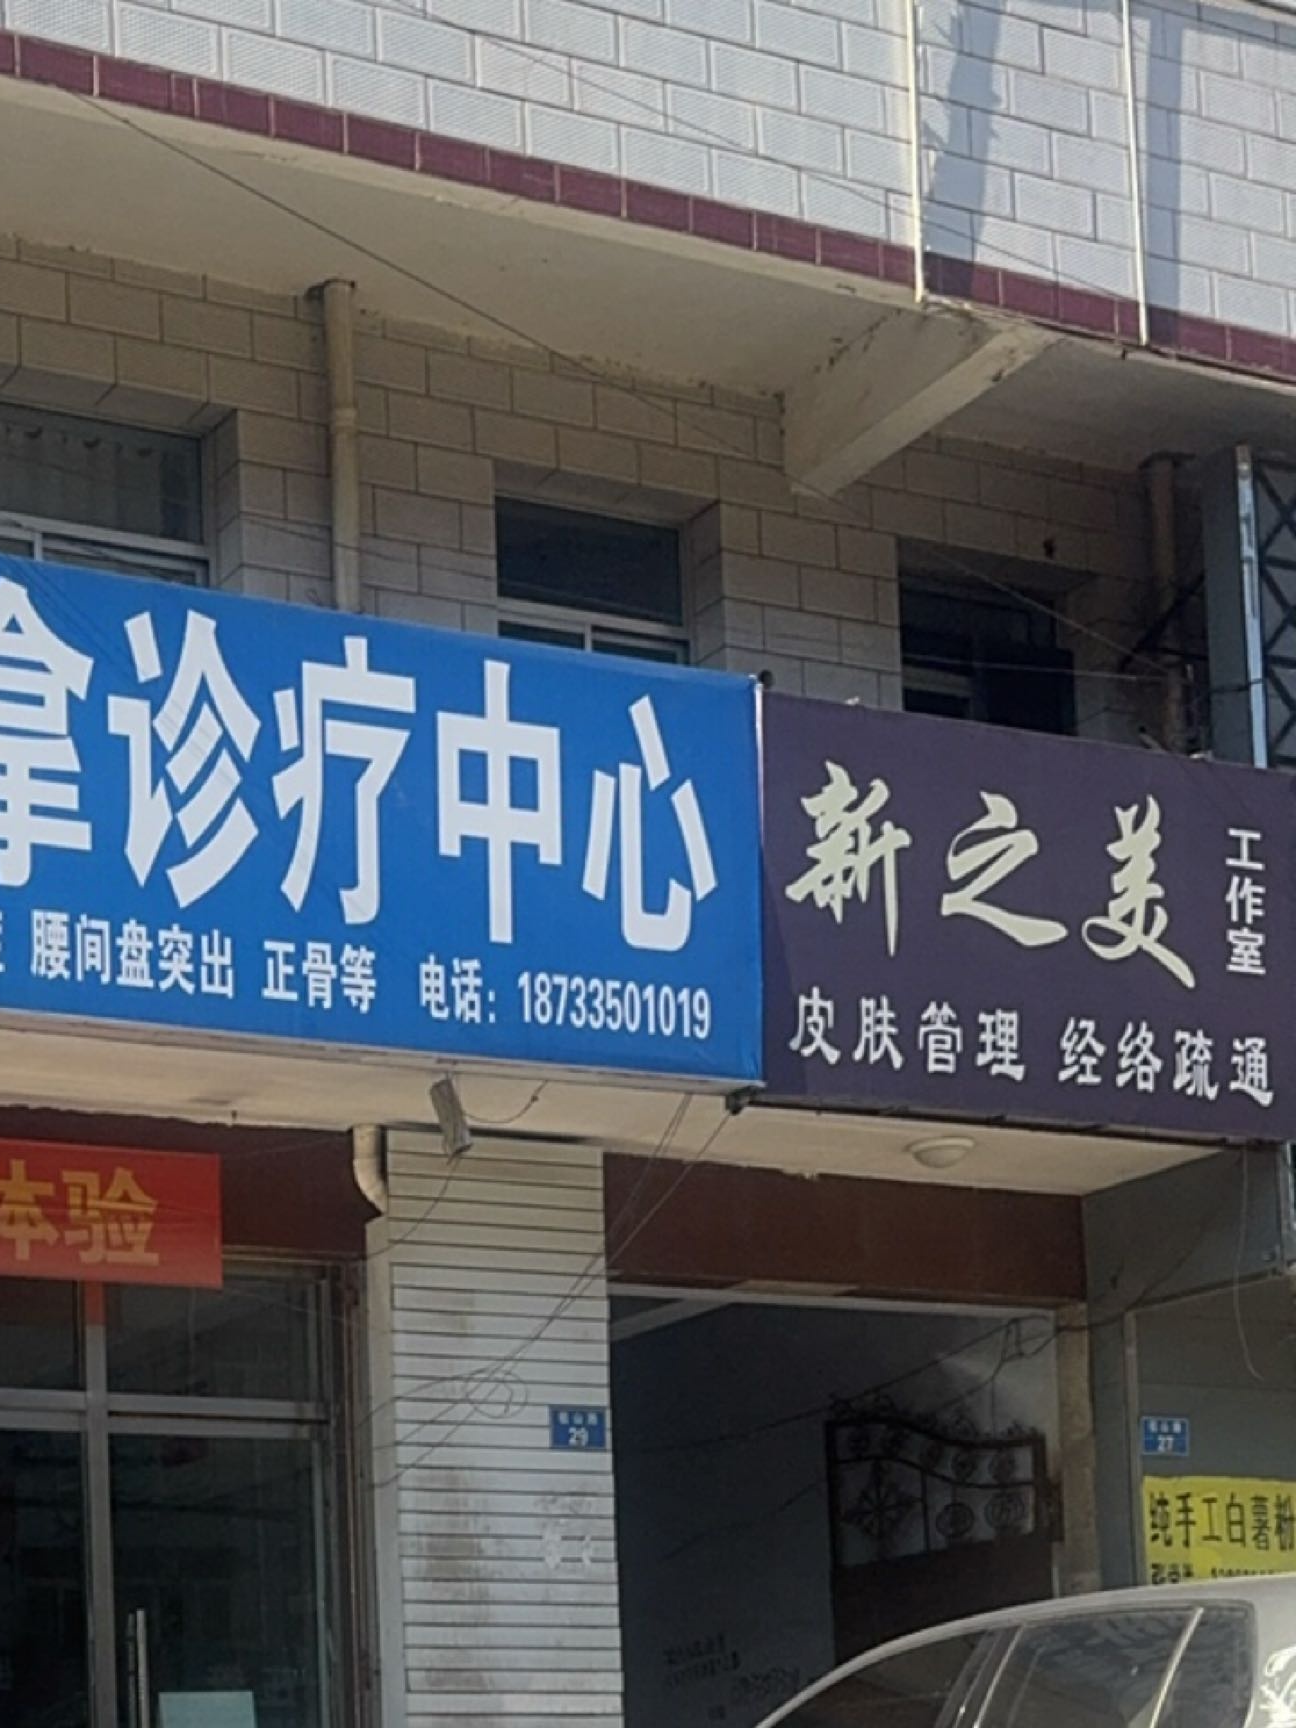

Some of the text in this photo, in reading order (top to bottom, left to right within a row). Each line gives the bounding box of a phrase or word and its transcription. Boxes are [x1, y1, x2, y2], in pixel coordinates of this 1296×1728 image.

[785, 760, 1196, 989] 新之美
[1226, 828, 1265, 974] 工作室
[31, 911, 232, 997] 腰间盘突出
[263, 941, 375, 1012] 正骨等
[519, 972, 709, 1038] 18733501019
[790, 987, 1273, 1106] 皮肤管理 经络疏通
